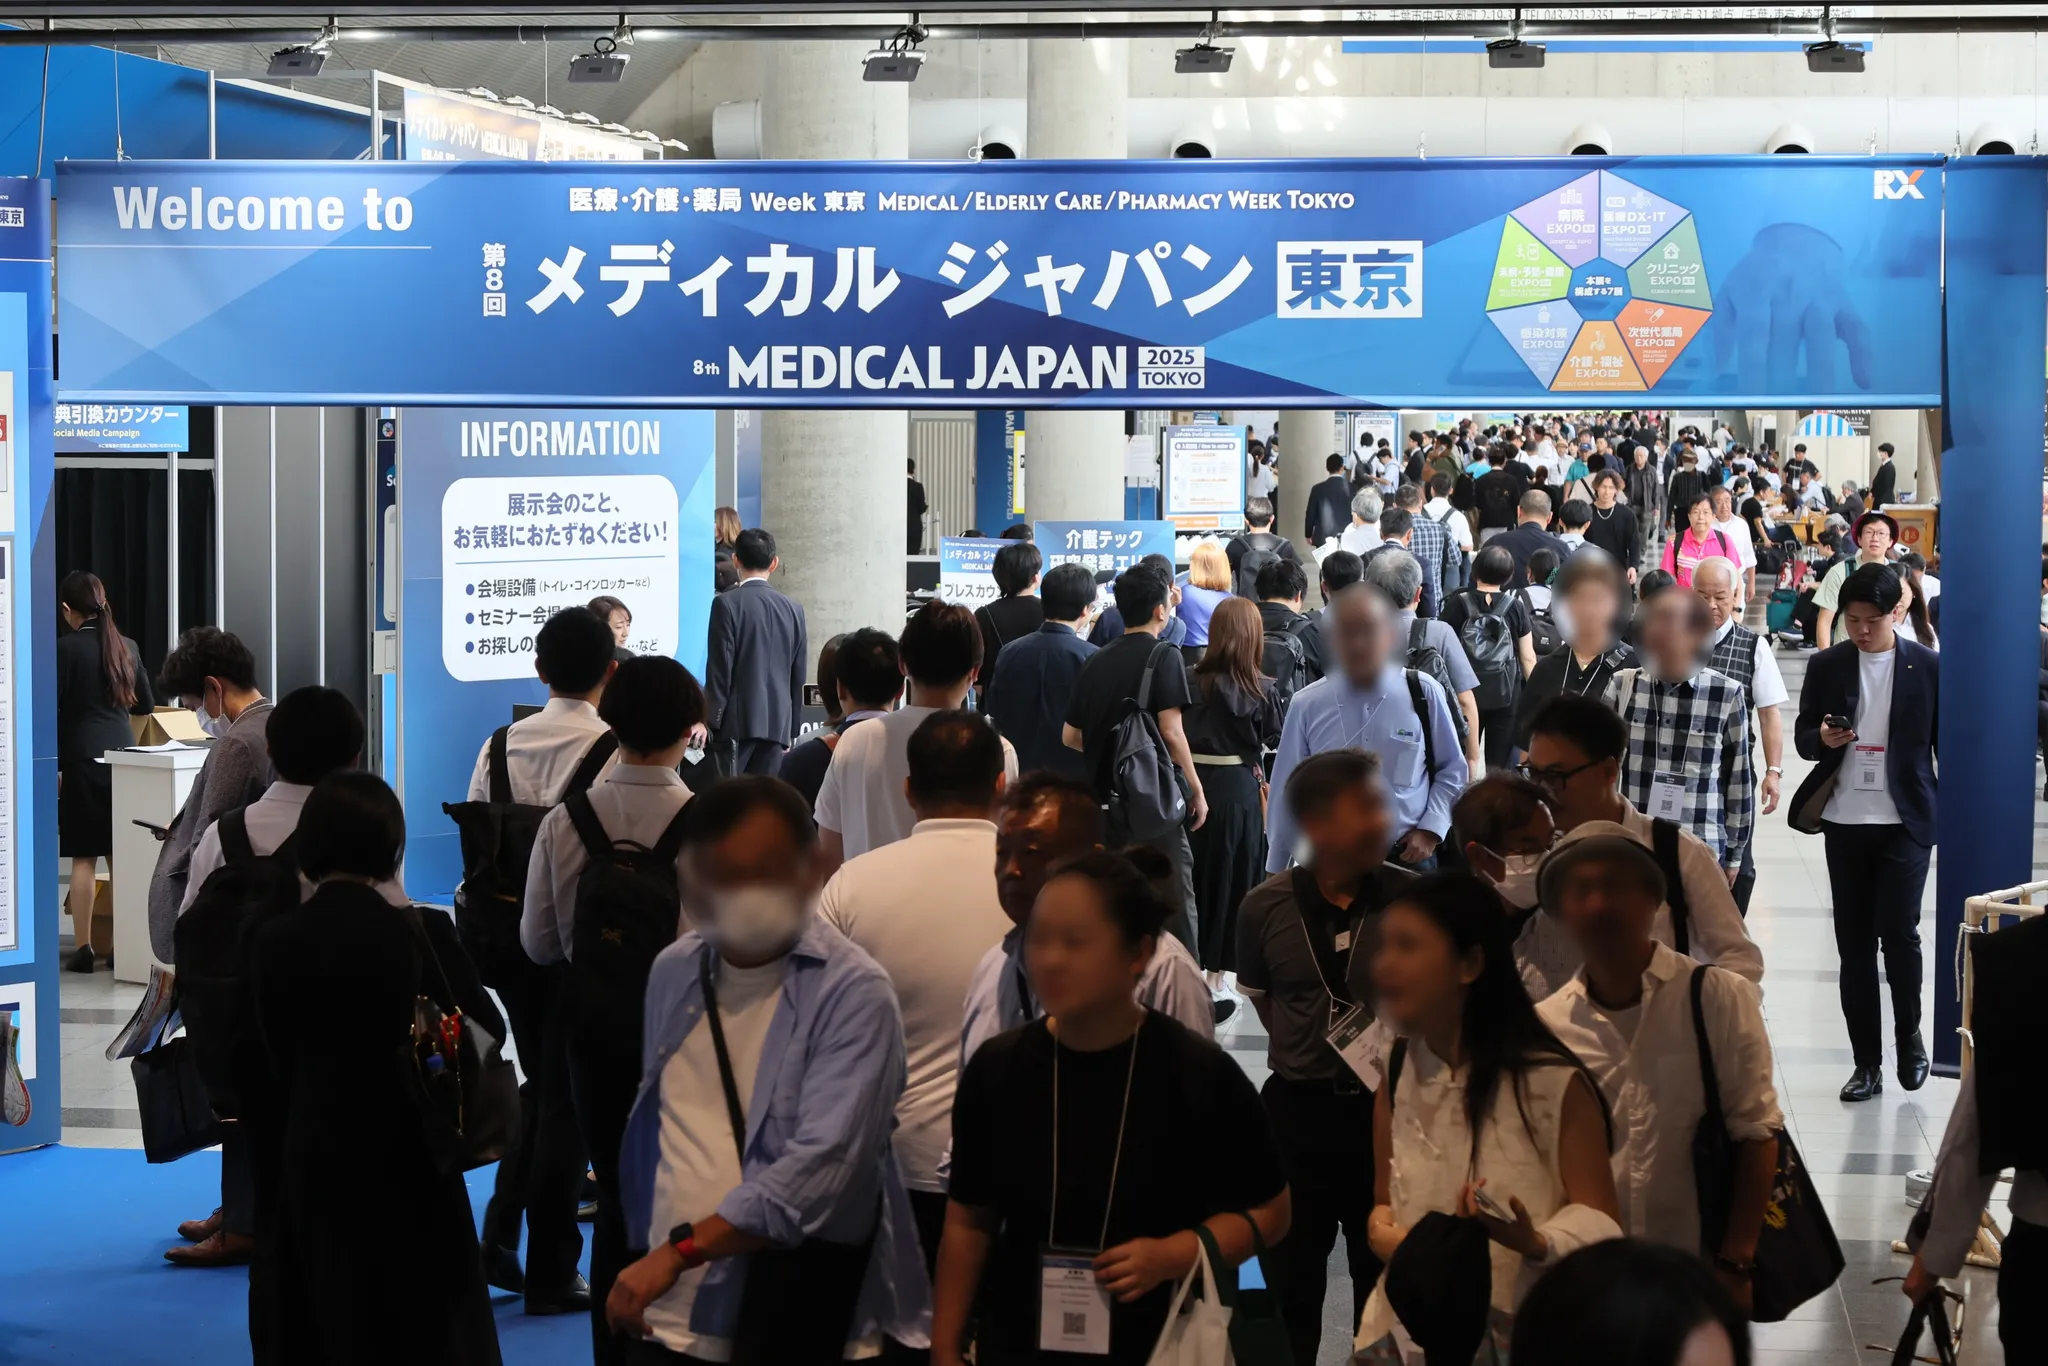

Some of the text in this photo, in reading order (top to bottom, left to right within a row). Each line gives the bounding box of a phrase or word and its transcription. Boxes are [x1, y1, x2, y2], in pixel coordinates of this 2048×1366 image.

[1874, 170, 1925, 199] RX
[570, 187, 865, 212] 医療・介護・薬局 Week 東京
[114, 187, 413, 231] Welcome to
[1546, 224, 1581, 234] EXPO
[1603, 225, 1636, 235] EXPO
[1646, 263, 1700, 275] クリニック
[482, 242, 506, 317] 第8回
[525, 240, 1414, 318] メディカル ジャパン 東京
[1510, 278, 1540, 288] EXPO
[1650, 276, 1682, 286] EXPO
[1520, 327, 1569, 339] 感染対策
[1628, 326, 1683, 338] 次世代薬局
[1522, 340, 1553, 349] EXPO
[1635, 339, 1663, 347] EXPO
[1147, 349, 1195, 365] 2025
[1569, 355, 1624, 368] 介護・福祉
[693, 345, 1127, 390] 8th MEDICAL JAPAN
[1575, 369, 1607, 378] EXPO
[1142, 371, 1202, 385] TOKYO
[54, 405, 180, 425] 典引換カウンター
[76, 428, 101, 437] Media
[102, 428, 141, 439] Campaign
[461, 420, 661, 457] INFORMATION
[507, 491, 620, 517] 展示会のこと、
[1065, 529, 1143, 550] 介護テック
[477, 578, 537, 599] 会場設備
[478, 635, 537, 656] お探しの
